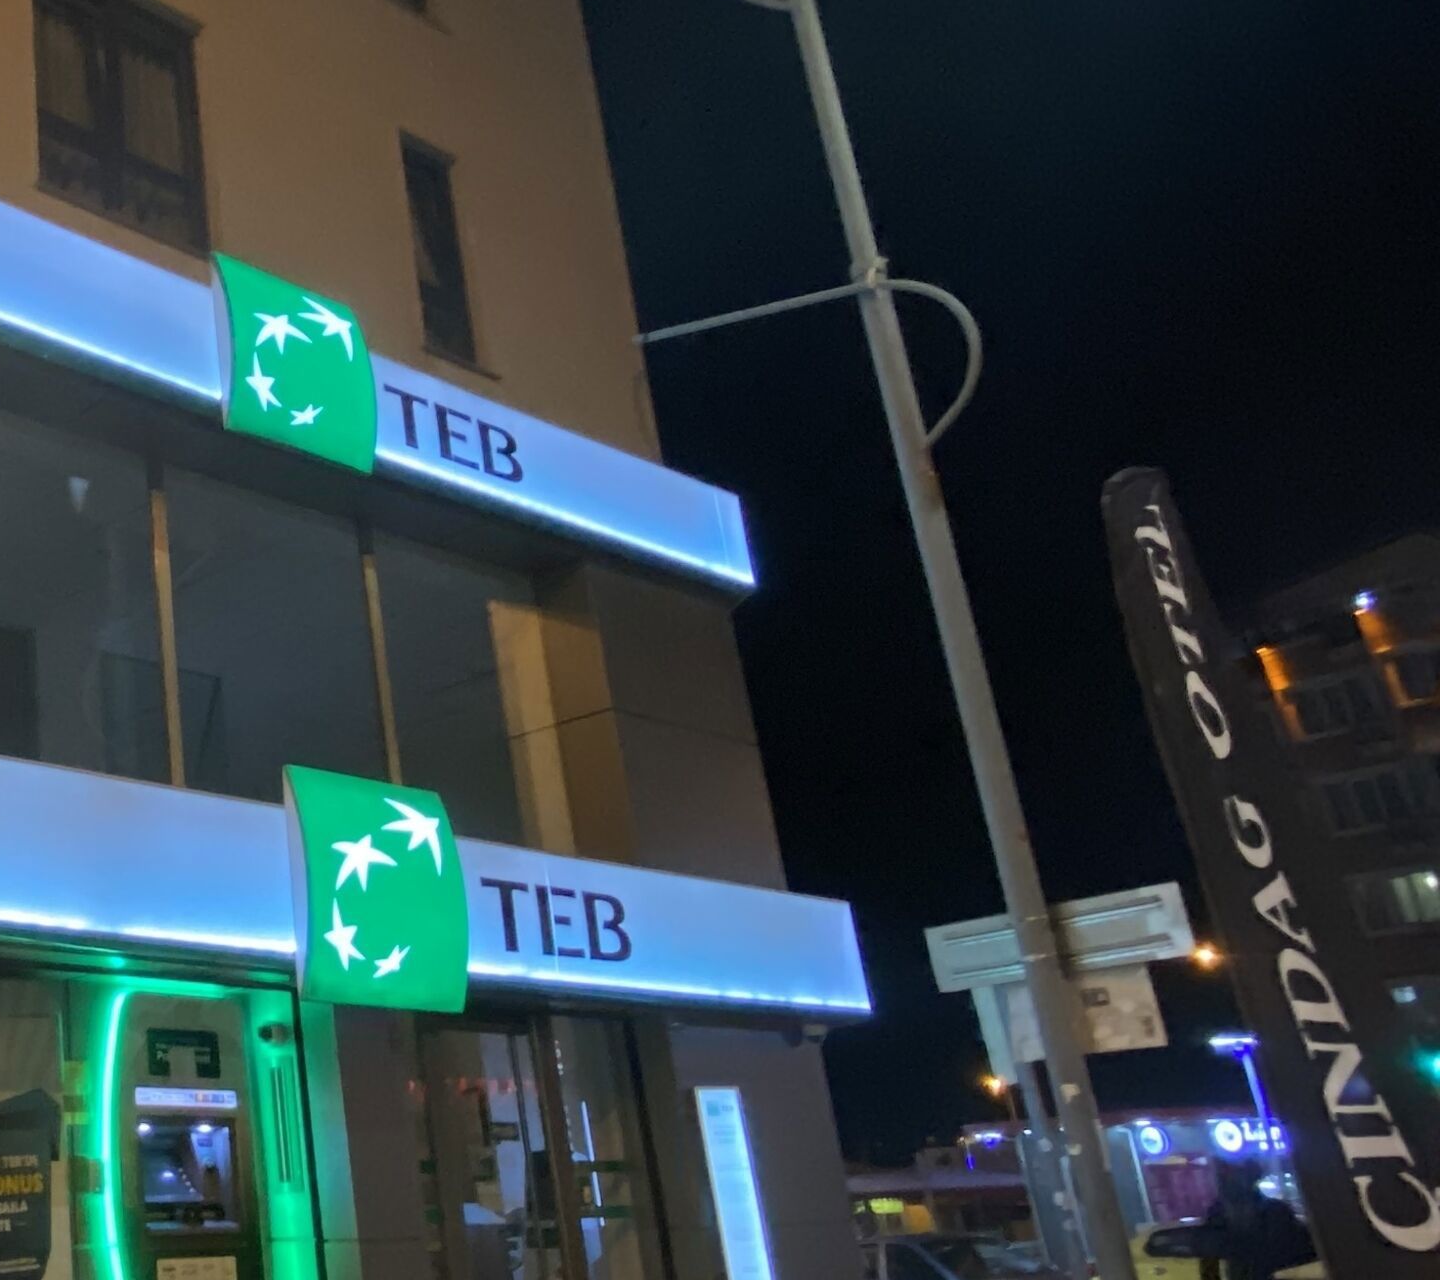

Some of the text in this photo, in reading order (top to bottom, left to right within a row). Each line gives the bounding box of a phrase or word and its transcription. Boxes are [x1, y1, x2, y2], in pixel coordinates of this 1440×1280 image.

[383, 383, 523, 483] TEB
[1134, 505, 1232, 760] OTEL
[481, 878, 631, 962] TEB
